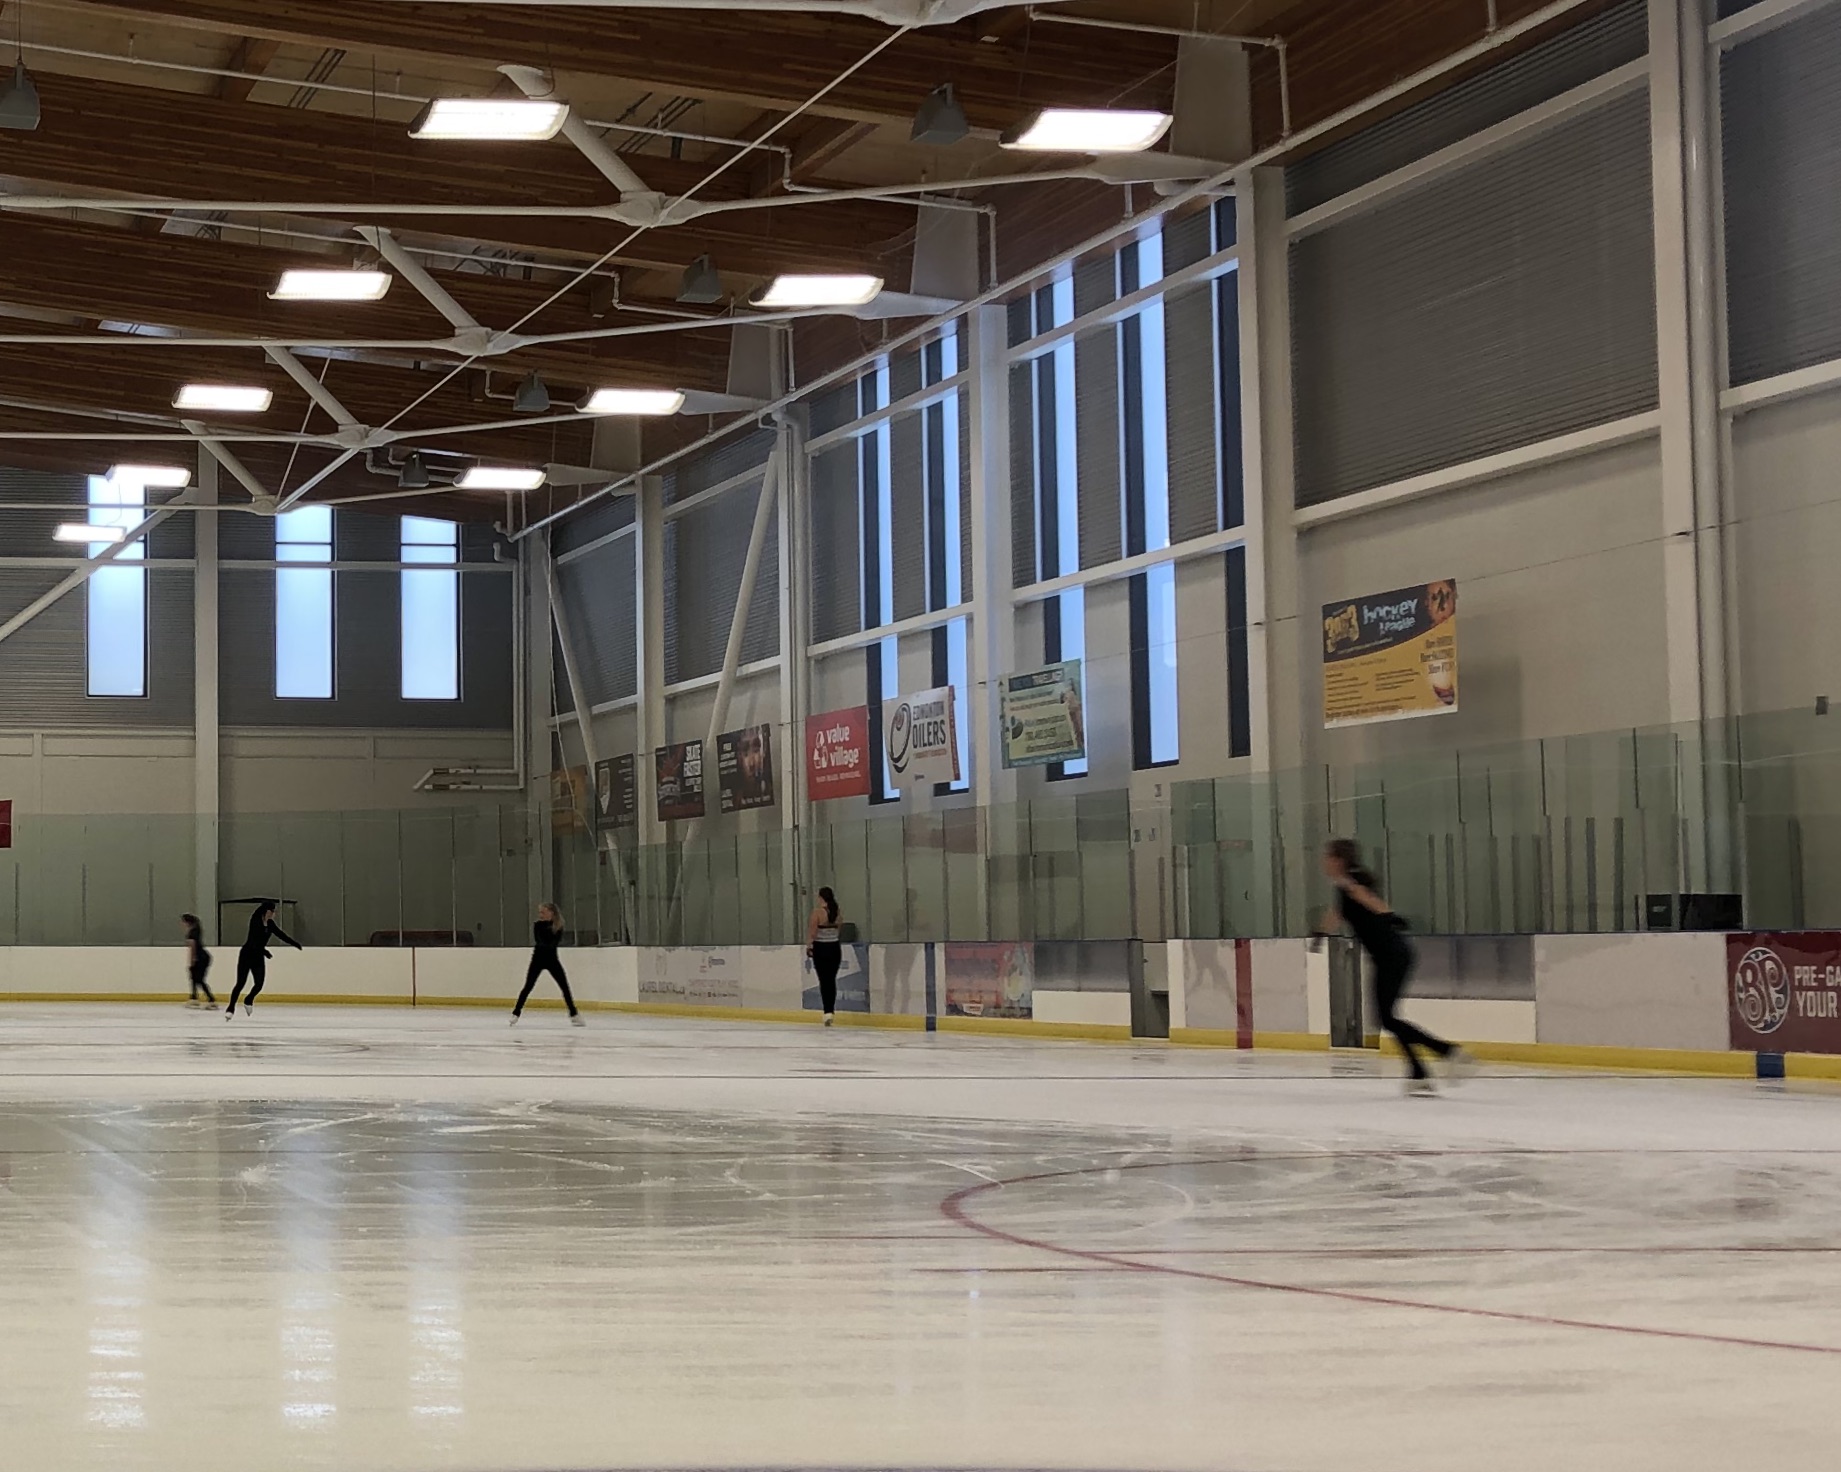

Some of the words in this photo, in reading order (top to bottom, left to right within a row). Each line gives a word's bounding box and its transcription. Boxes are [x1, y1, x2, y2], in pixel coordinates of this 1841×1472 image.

[1363, 599, 1418, 624] hockey
[913, 701, 945, 721] EDMONTON
[827, 723, 850, 744] value
[913, 719, 946, 749] OILERS
[830, 746, 859, 768] village
[1795, 991, 1838, 1018] YOUR
